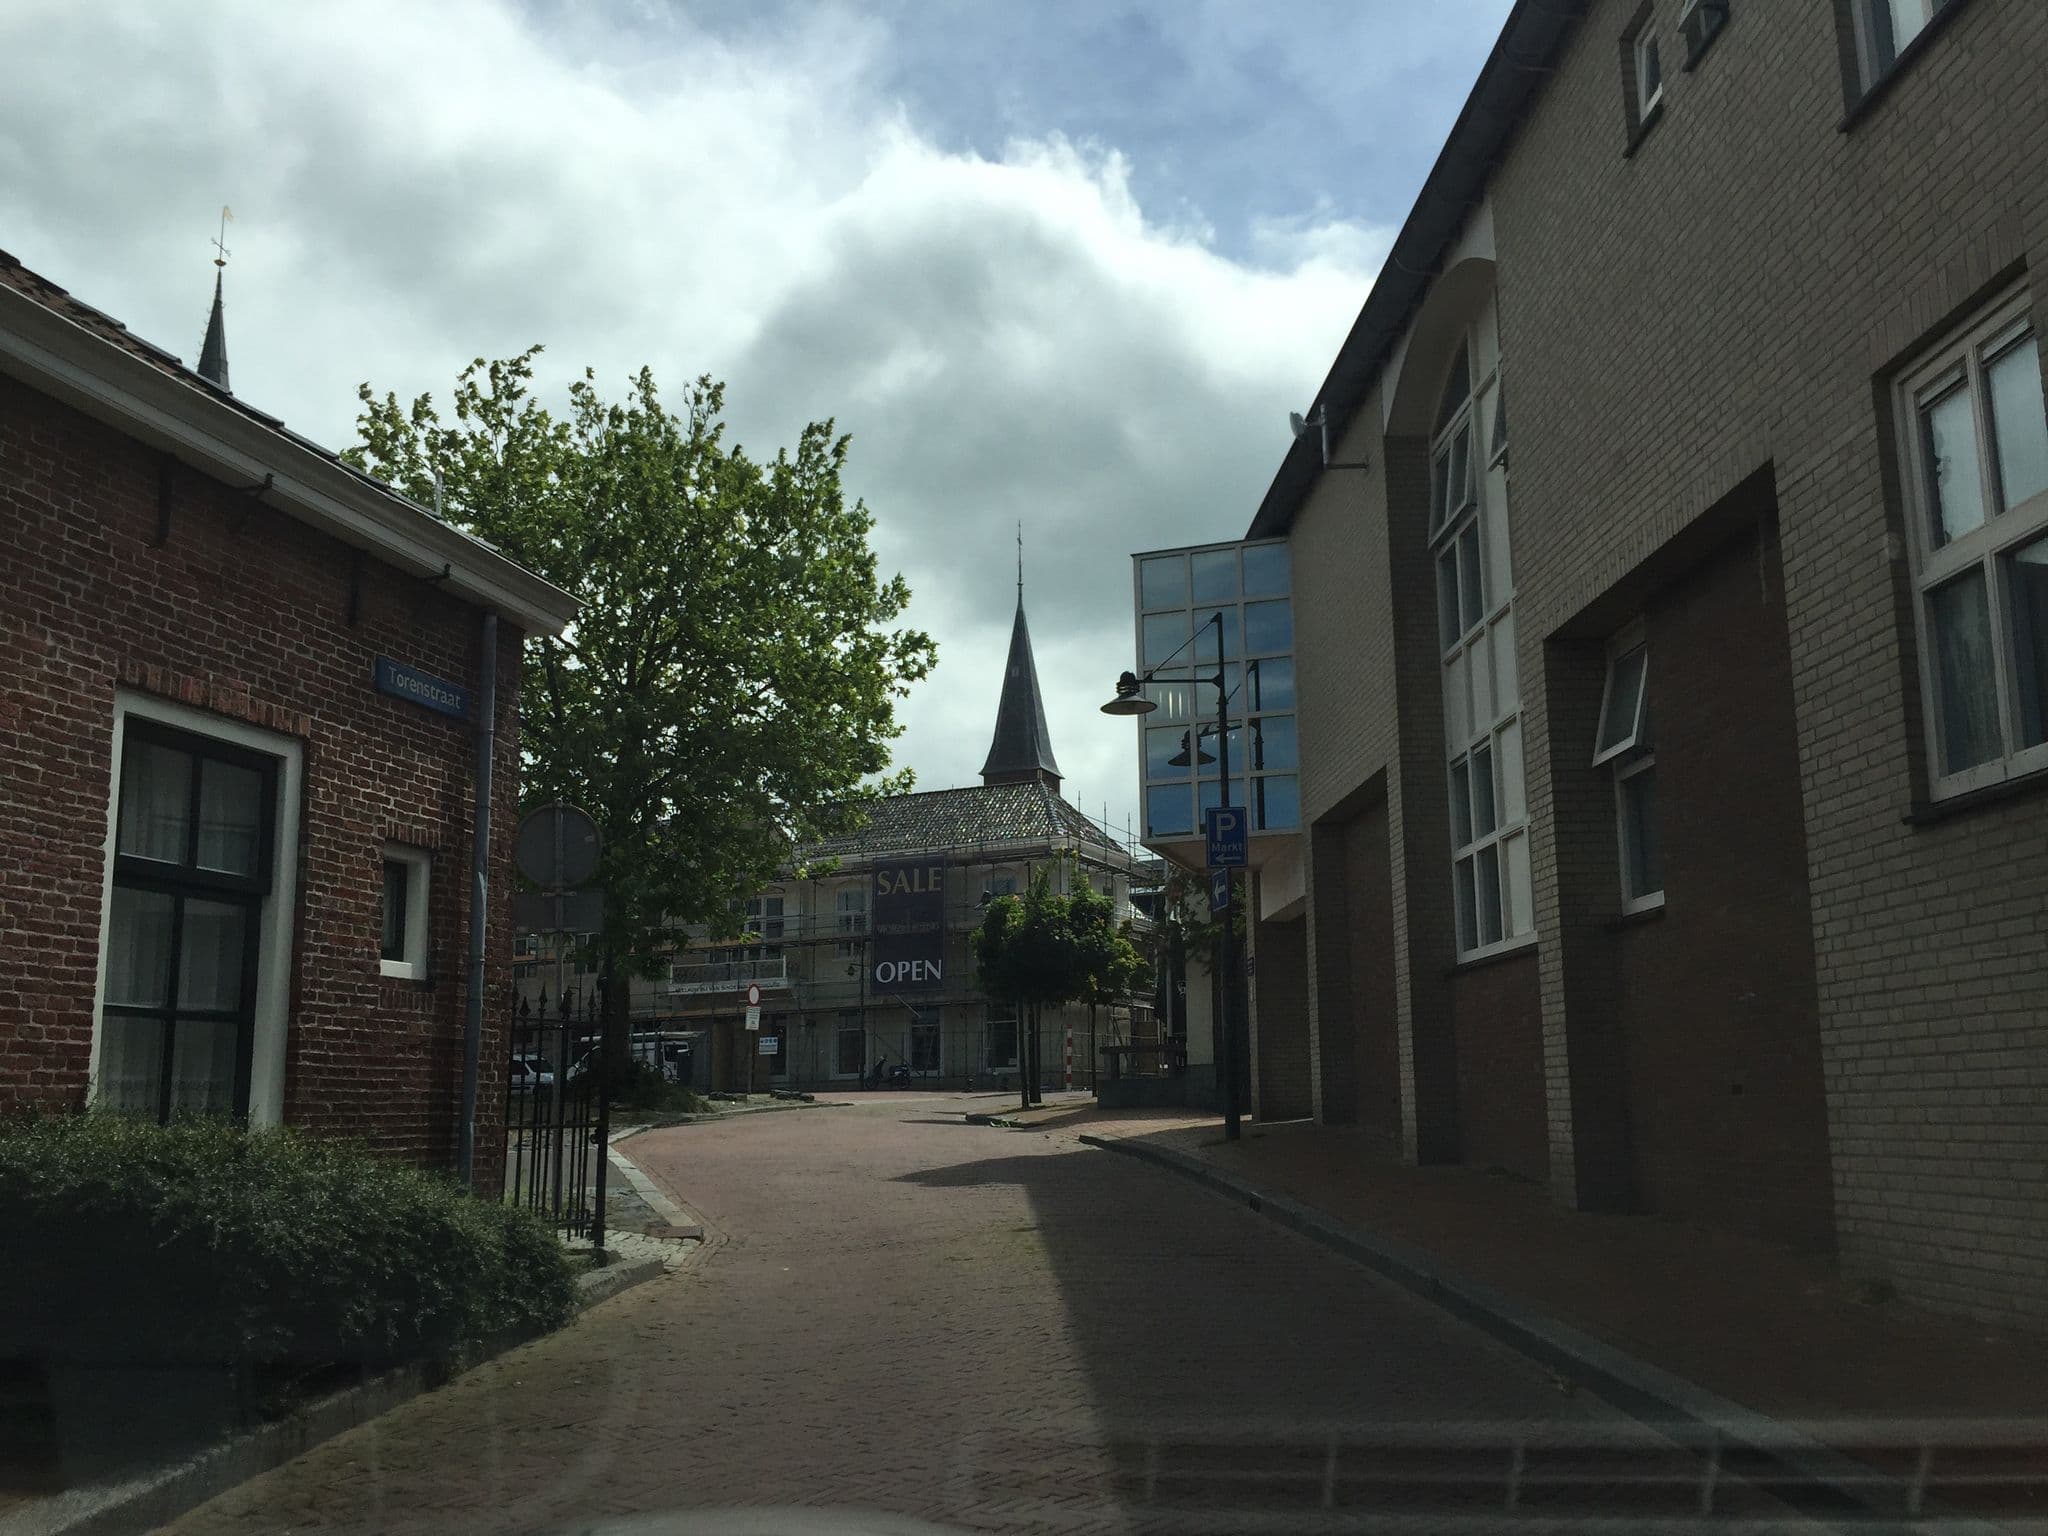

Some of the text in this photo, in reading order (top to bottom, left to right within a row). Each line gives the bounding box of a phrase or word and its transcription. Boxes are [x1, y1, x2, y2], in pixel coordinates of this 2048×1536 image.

[388, 665, 461, 709] Torenstraat
[1216, 813, 1236, 841] P
[1212, 842, 1242, 853] Markt
[877, 867, 942, 895] SALE
[875, 960, 942, 983] OPEN
